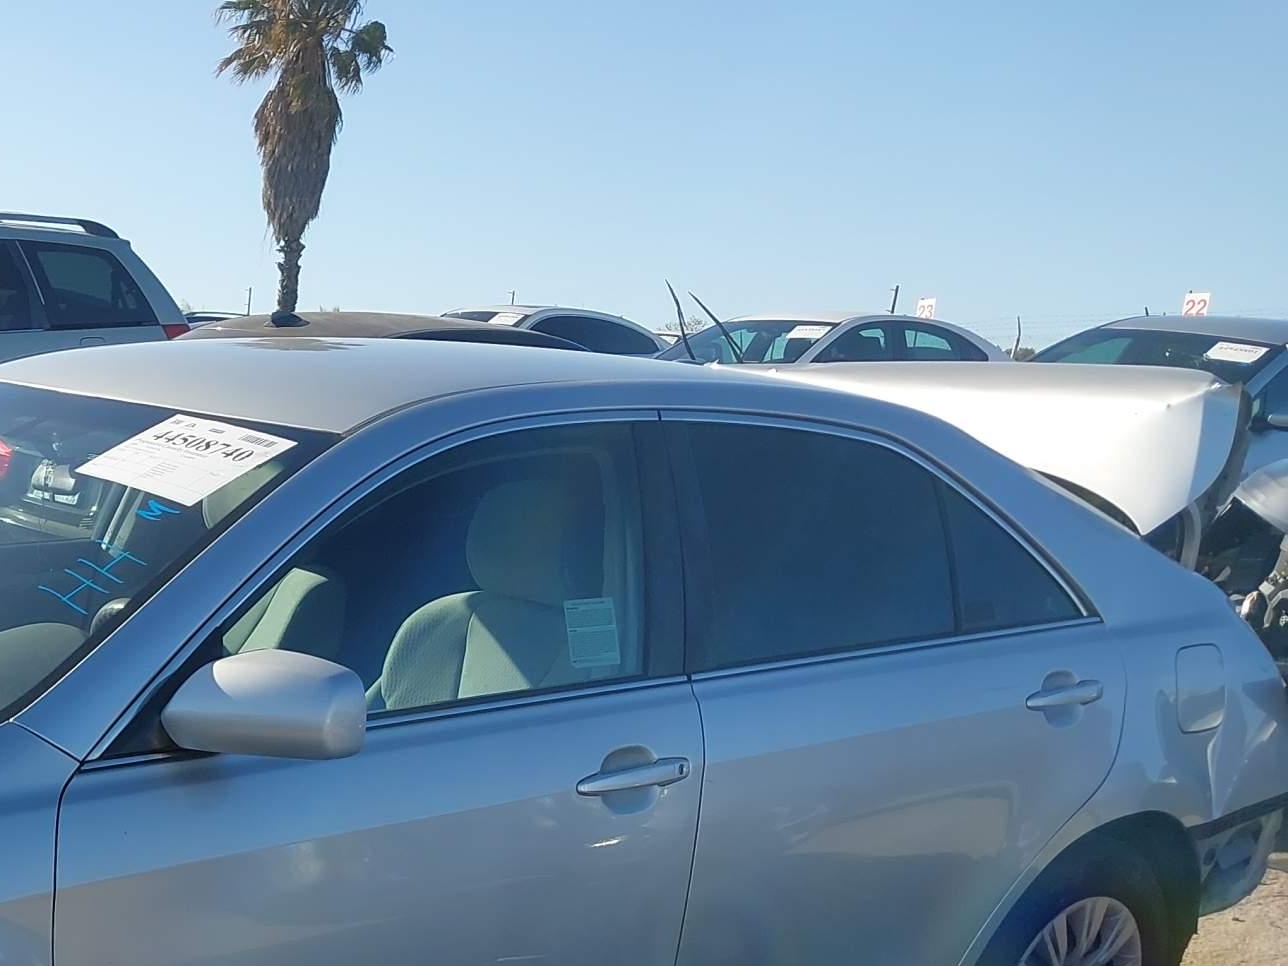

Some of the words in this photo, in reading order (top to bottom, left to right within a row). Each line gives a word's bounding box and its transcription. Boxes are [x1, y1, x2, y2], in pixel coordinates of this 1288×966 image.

[918, 304, 934, 319] 23
[1184, 298, 1208, 317] 22
[152, 430, 255, 463] 44508740
